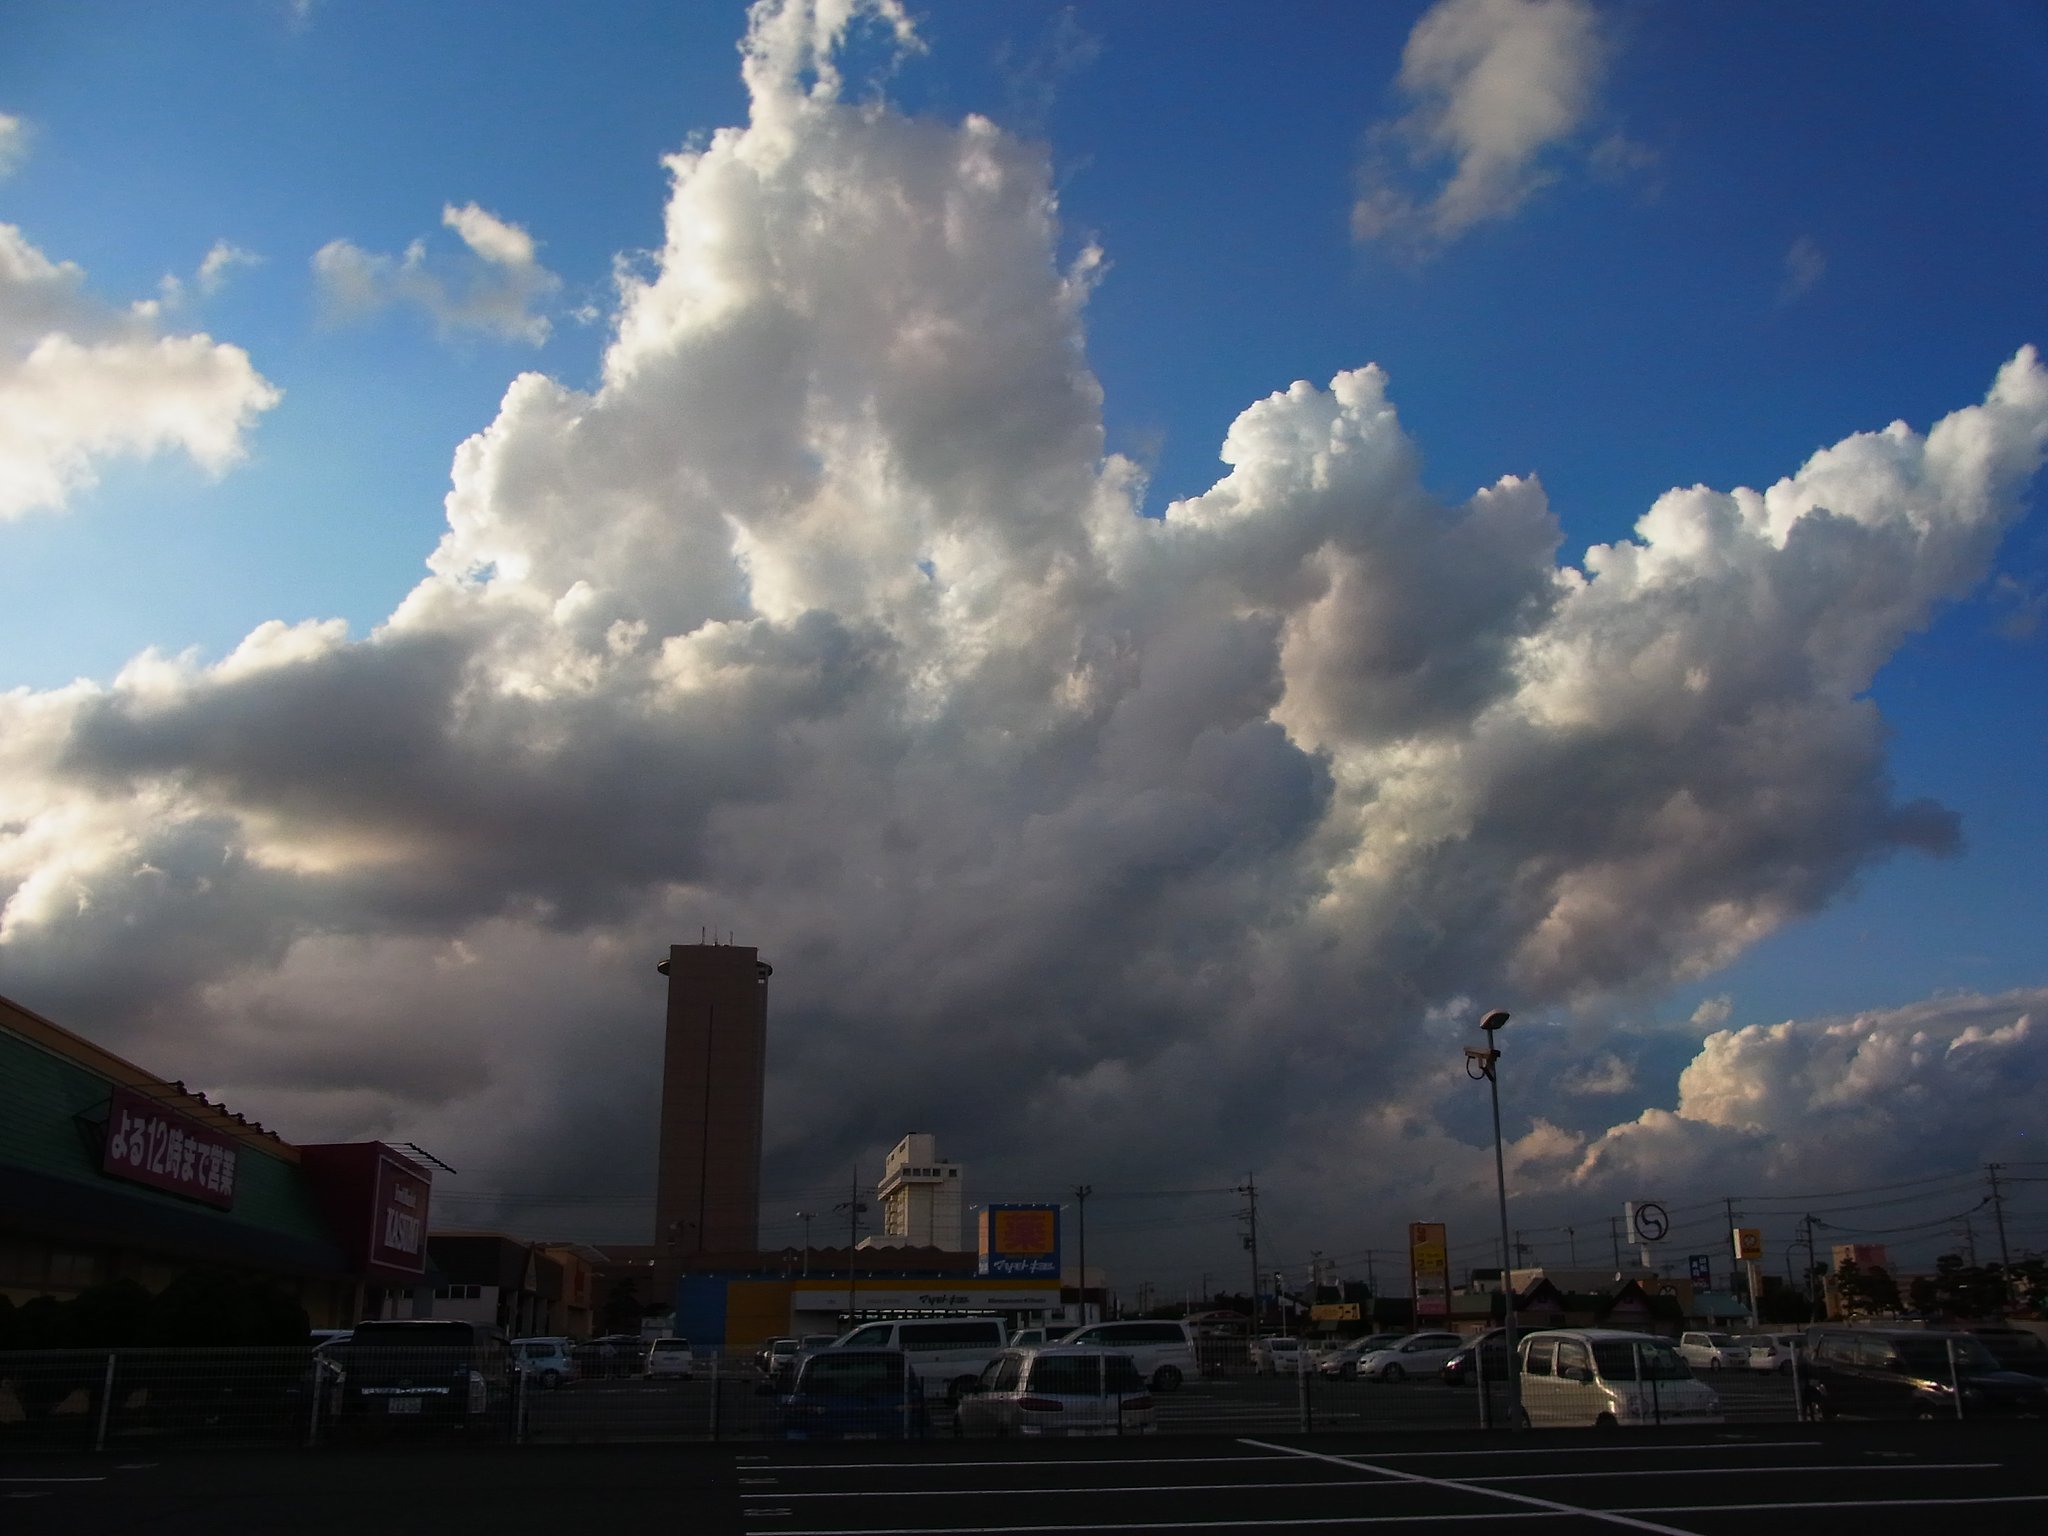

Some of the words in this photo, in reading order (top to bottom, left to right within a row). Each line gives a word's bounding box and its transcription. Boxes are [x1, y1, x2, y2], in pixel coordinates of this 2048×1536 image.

[111, 1109, 236, 1197] よる12時まで営業
